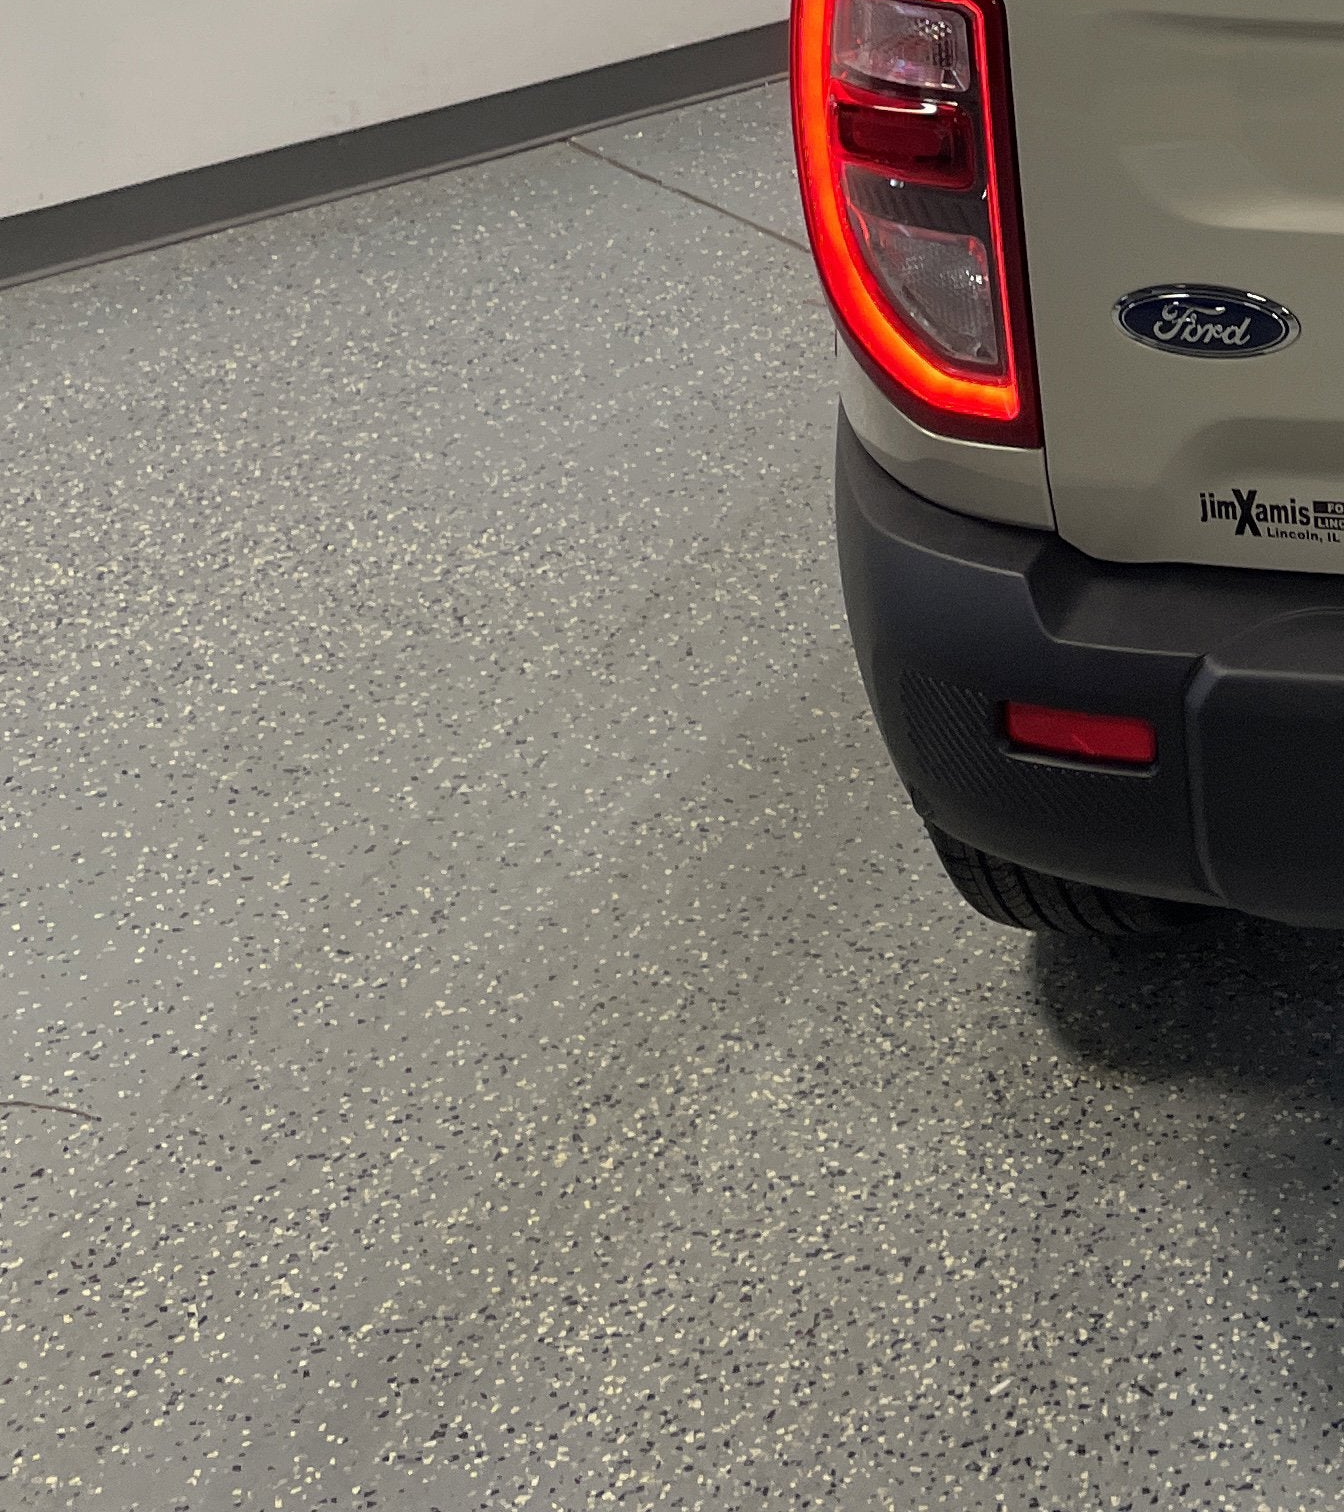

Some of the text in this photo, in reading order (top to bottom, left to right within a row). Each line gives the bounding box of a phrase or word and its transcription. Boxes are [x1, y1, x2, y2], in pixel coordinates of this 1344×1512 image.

[1153, 302, 1250, 346] Ford
[1267, 527, 1340, 542] Lincoln, IL
